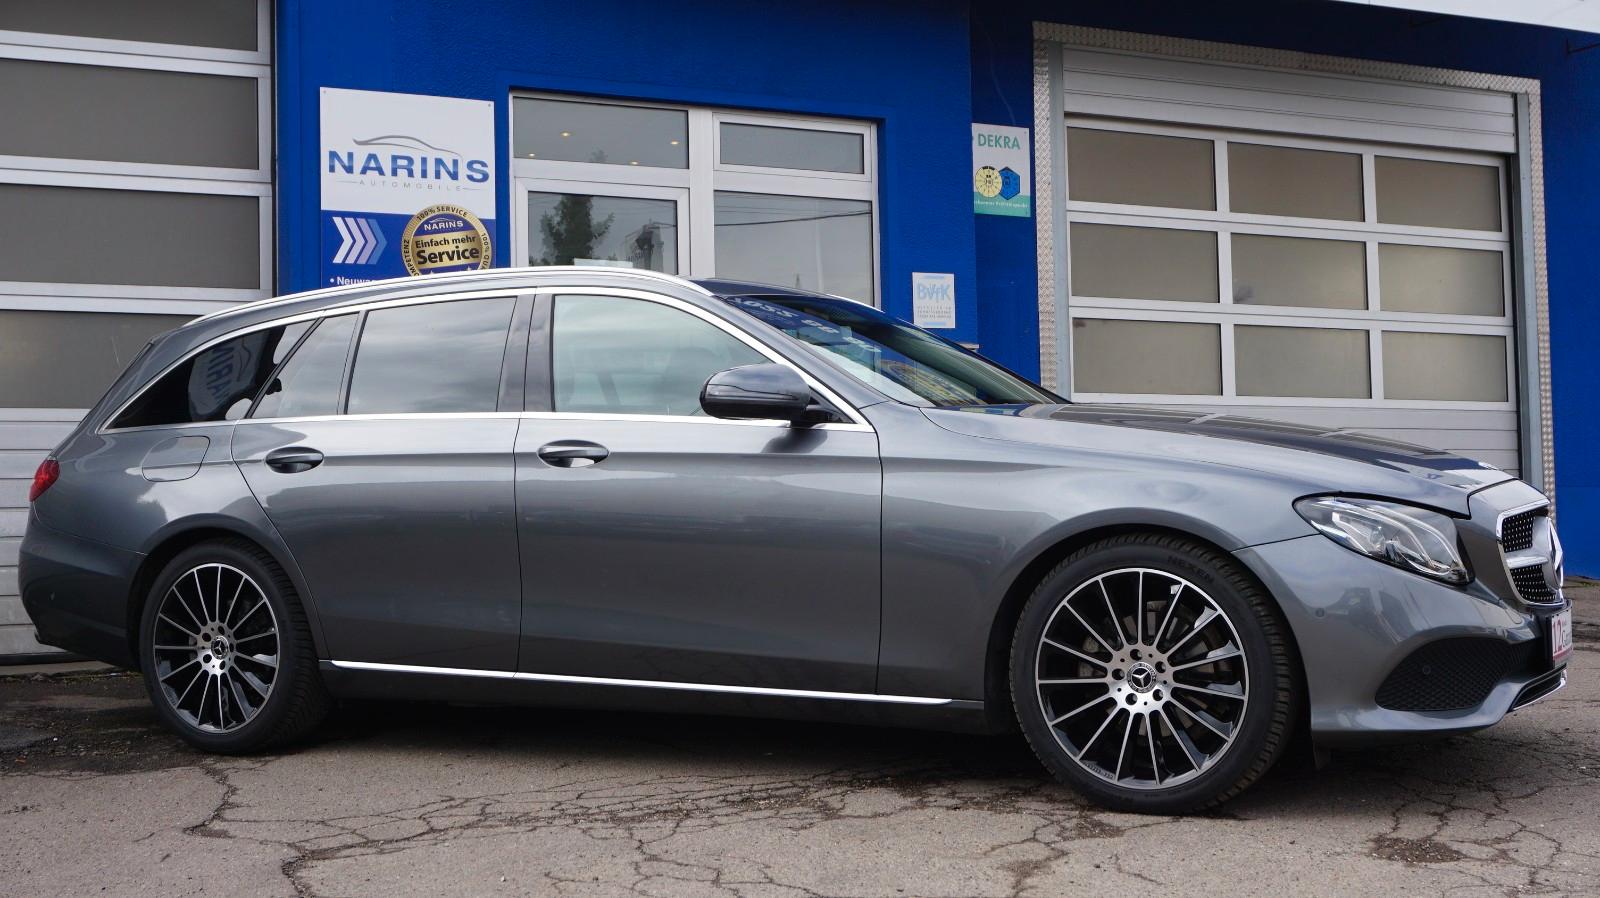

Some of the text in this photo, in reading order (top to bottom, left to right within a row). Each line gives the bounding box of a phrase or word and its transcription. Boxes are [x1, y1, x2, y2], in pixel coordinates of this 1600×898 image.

[977, 133, 1021, 150] DEKRA
[329, 151, 489, 183] NARINS
[359, 180, 461, 191] AUTOMOBILE
[417, 206, 467, 220] 100% SERVICE
[424, 221, 463, 230] NARINS
[415, 235, 476, 249] Einfach mehr
[416, 245, 480, 265] Service
